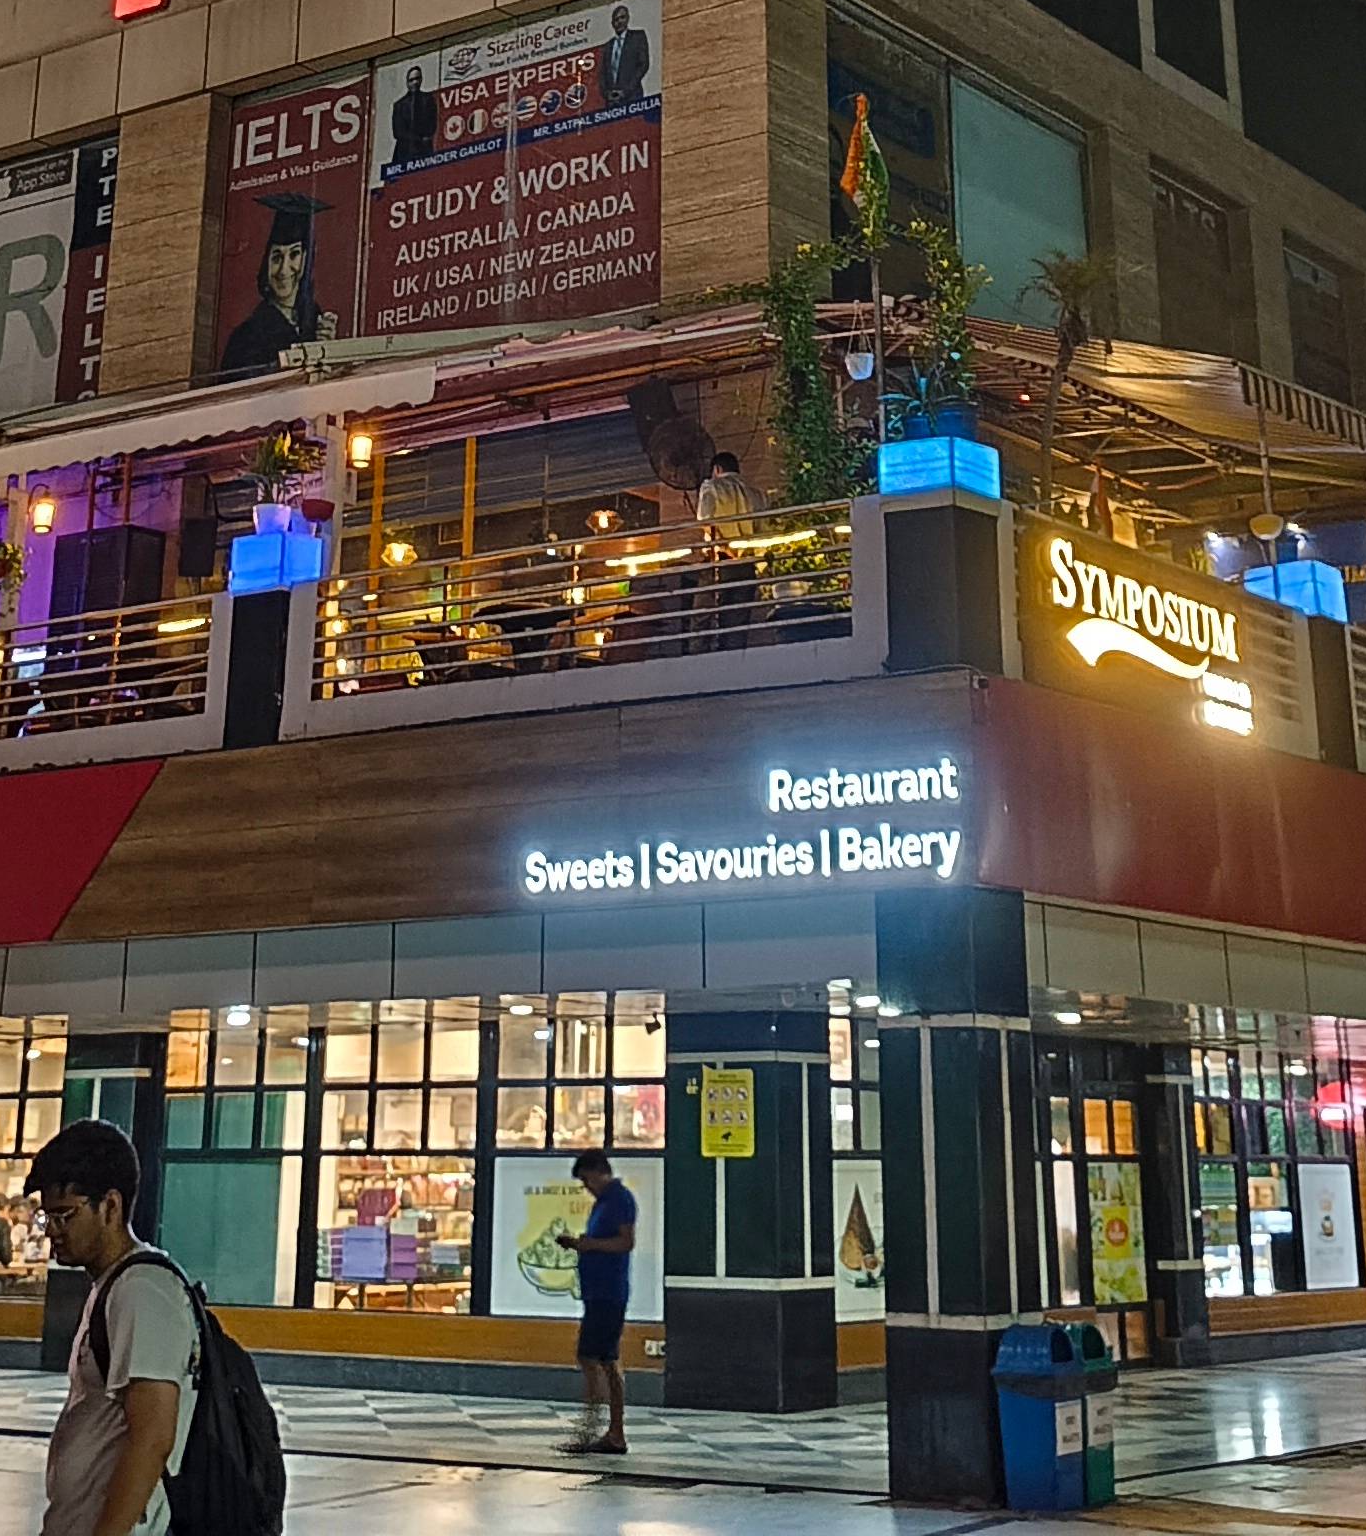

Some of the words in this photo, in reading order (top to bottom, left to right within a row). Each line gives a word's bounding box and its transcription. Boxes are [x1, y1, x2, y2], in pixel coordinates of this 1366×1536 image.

[441, 80, 489, 109] VISA
[494, 51, 595, 96] EXPERTS
[232, 94, 361, 169] IELTS
[533, 126, 553, 138] MR.
[554, 118, 593, 134] SATPAL
[593, 109, 627, 124] SINGH
[628, 98, 661, 114] GULIA
[16, 178, 38, 193] App
[39, 169, 67, 184] Store
[96, 146, 118, 227] PTE
[228, 172, 278, 192] Admission
[280, 168, 288, 180] &
[290, 164, 310, 177] Visa
[312, 153, 359, 172] Guidance
[386, 163, 406, 176] MR.
[406, 150, 458, 172] RAVINDER
[459, 138, 503, 158] GAHLOT
[388, 184, 483, 230] STUDY
[490, 175, 510, 205] &
[519, 151, 613, 198] WORK
[620, 140, 650, 171] IN
[393, 278, 420, 298] UK
[434, 265, 475, 290] USA
[490, 249, 534, 277] NEW
[538, 226, 635, 266] ZEALAND
[395, 223, 520, 266] AUSTRALIA
[537, 192, 635, 233] CANADA
[377, 295, 460, 330] IRELAND
[476, 278, 536, 308] DUBAI
[553, 251, 657, 292] GERMANY
[1050, 537, 1240, 664] SYMPOSIUM
[768, 757, 960, 813] Restaurant
[525, 851, 634, 893] Sweets
[656, 833, 813, 885] Savouries
[838, 823, 961, 879] Bakery
